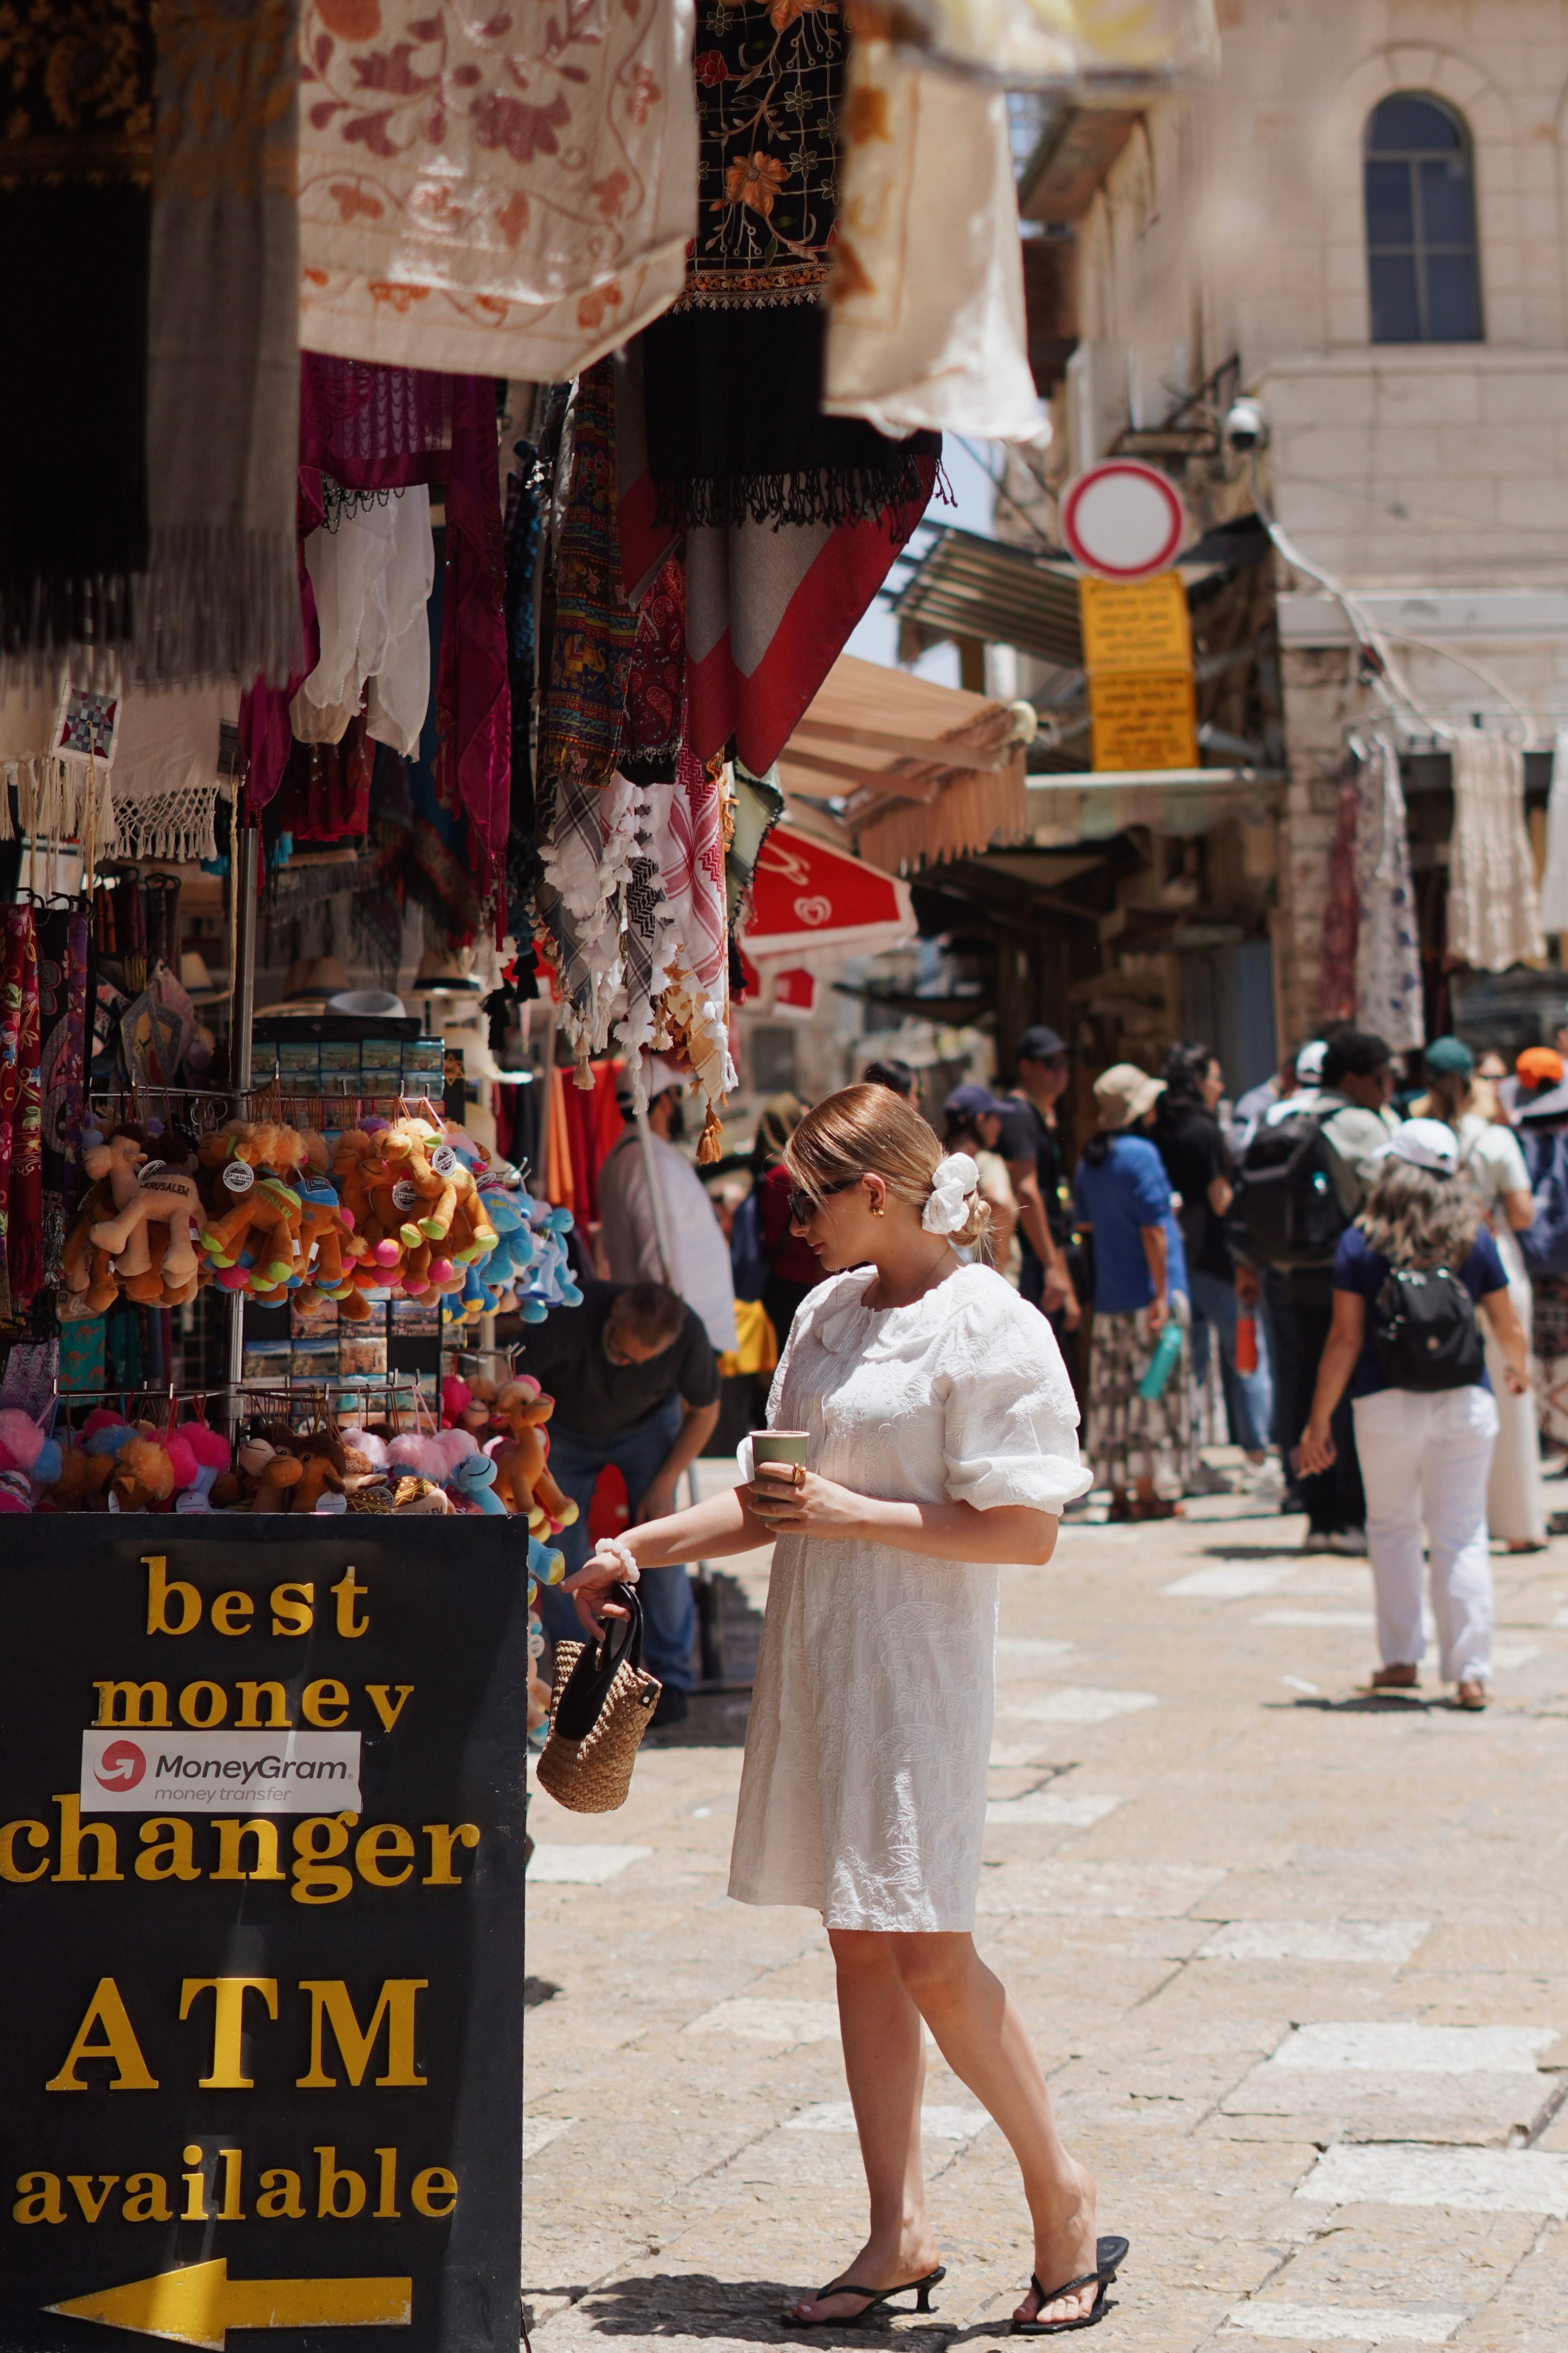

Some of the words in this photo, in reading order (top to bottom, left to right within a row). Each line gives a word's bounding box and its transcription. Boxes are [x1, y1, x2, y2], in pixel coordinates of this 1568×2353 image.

[436, 1154, 454, 1168] Original
[139, 1181, 190, 1197] JERUSALEM
[142, 1556, 369, 1637] best
[154, 1789, 216, 1803] money
[220, 1786, 292, 1801] transfer
[155, 1755, 347, 1785] MoneyGram
[0, 1794, 480, 1904] changer
[46, 1977, 429, 2091] ATM
[14, 2144, 458, 2224] available
